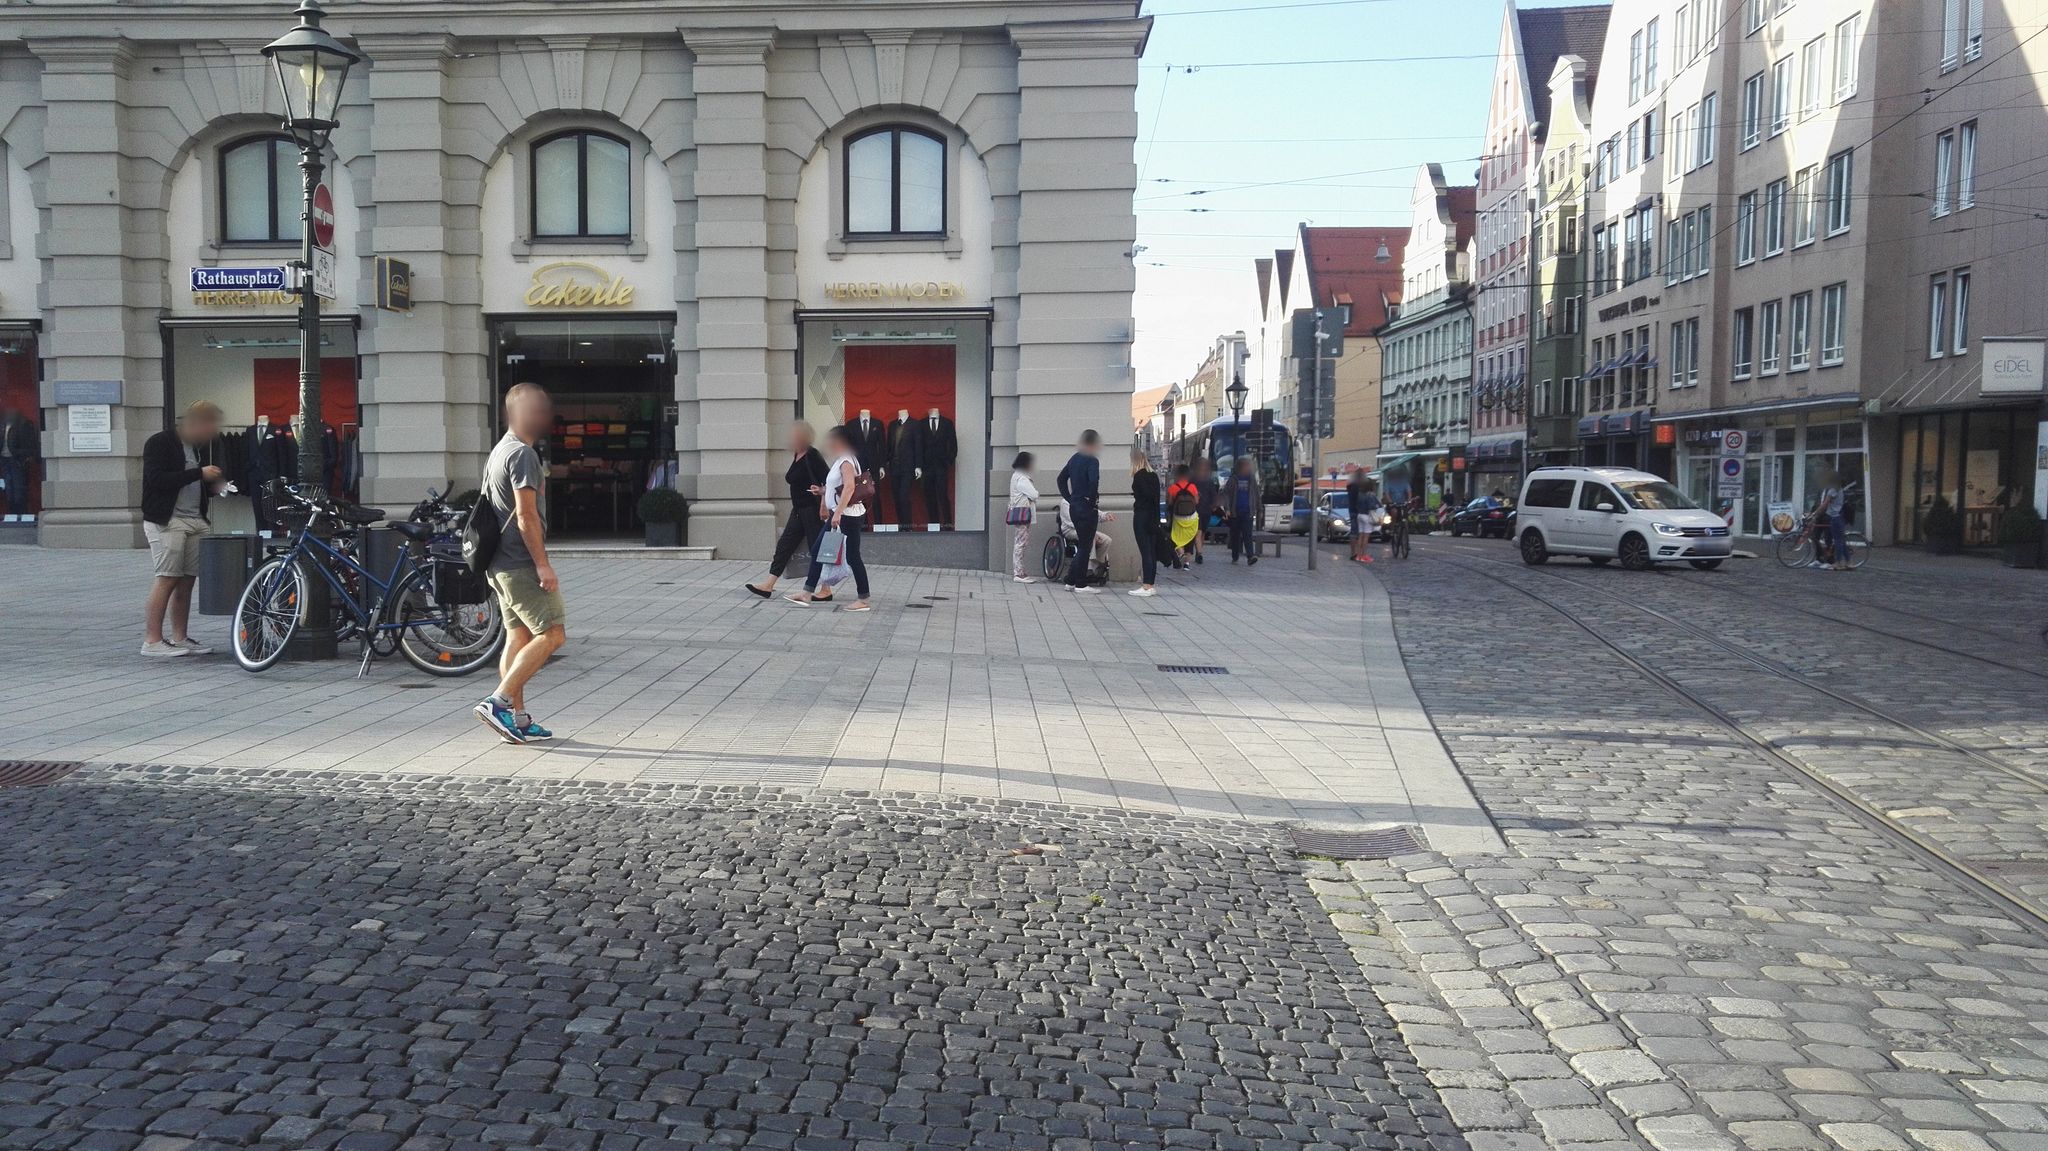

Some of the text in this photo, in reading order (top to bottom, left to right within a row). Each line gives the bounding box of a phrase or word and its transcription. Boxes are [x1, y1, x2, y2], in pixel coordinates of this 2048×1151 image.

[197, 271, 280, 288] Rathausplatz
[524, 262, 635, 306] Eckerle
[824, 281, 966, 298] HERRENMODEN
[1994, 359, 2033, 373] EIDEL
[1729, 436, 1740, 445] 20
